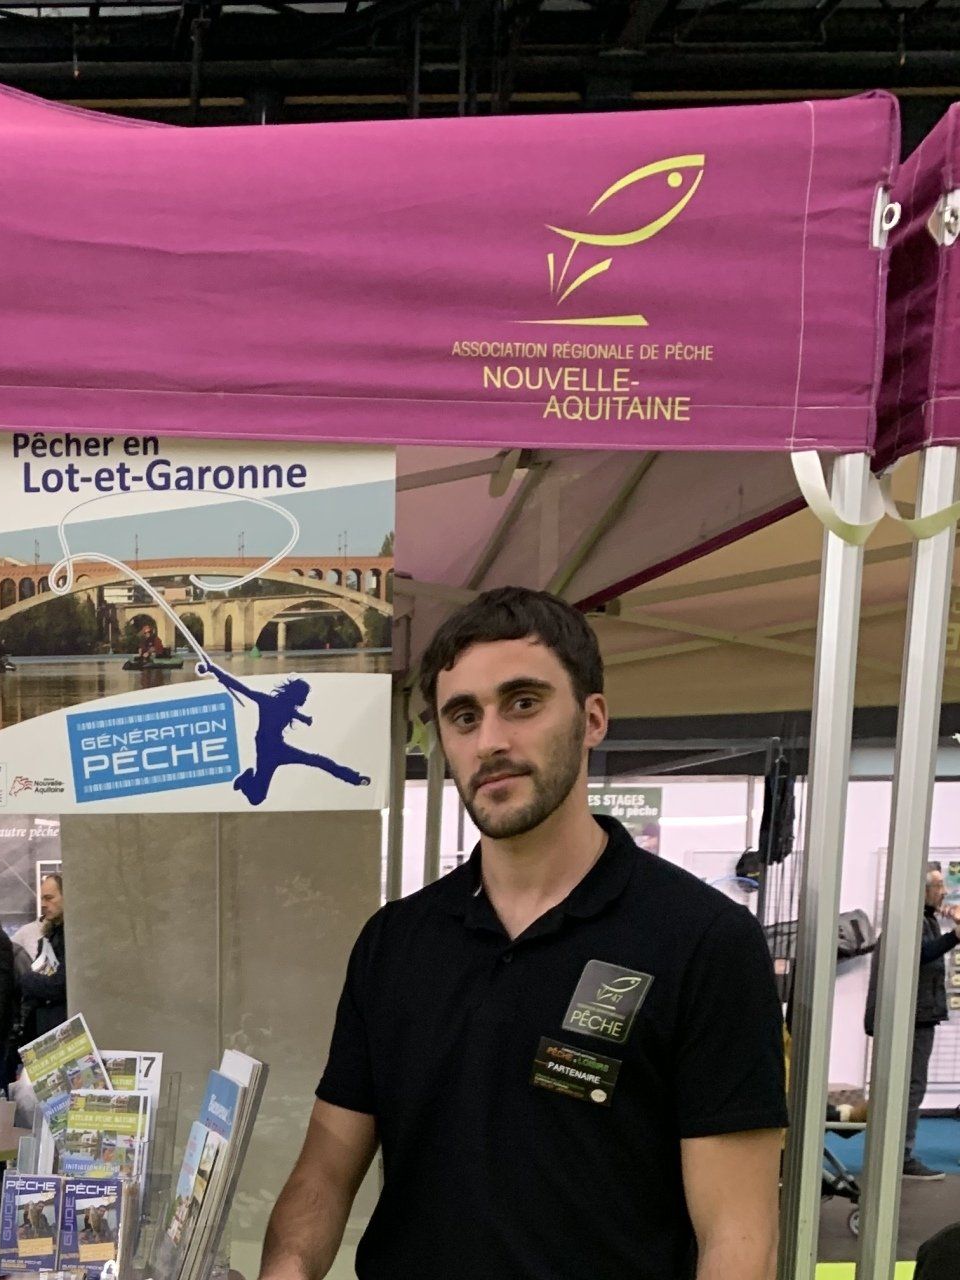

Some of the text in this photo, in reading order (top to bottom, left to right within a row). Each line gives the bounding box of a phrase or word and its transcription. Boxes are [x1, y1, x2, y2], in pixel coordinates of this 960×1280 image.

[452, 342, 713, 361] ASSOCIATION RÉGIONALE DE PÊCHE
[483, 366, 639, 392] NOUVELLE-
[542, 395, 690, 421] AQUITAINE
[13, 433, 159, 458] Pêcher en
[23, 459, 307, 493] Lot-et-Garonne
[80, 717, 227, 752] GÉNÉRATION
[83, 737, 230, 779] PÊCHE
[588, 794, 645, 806] ES STAGES
[611, 806, 658, 818] de pêche
[28, 826, 60, 841] pêche
[611, 993, 623, 1003] 47
[570, 1010, 624, 1037] PÊCHE
[143, 1057, 156, 1078] 7
[547, 1062, 602, 1084] PARTENAIRE
[6, 1179, 56, 1192] PÊCHE
[66, 1182, 117, 1196] PÊCHE
[2, 1191, 14, 1242] GUIDE
[63, 1195, 75, 1246] GUIDE
